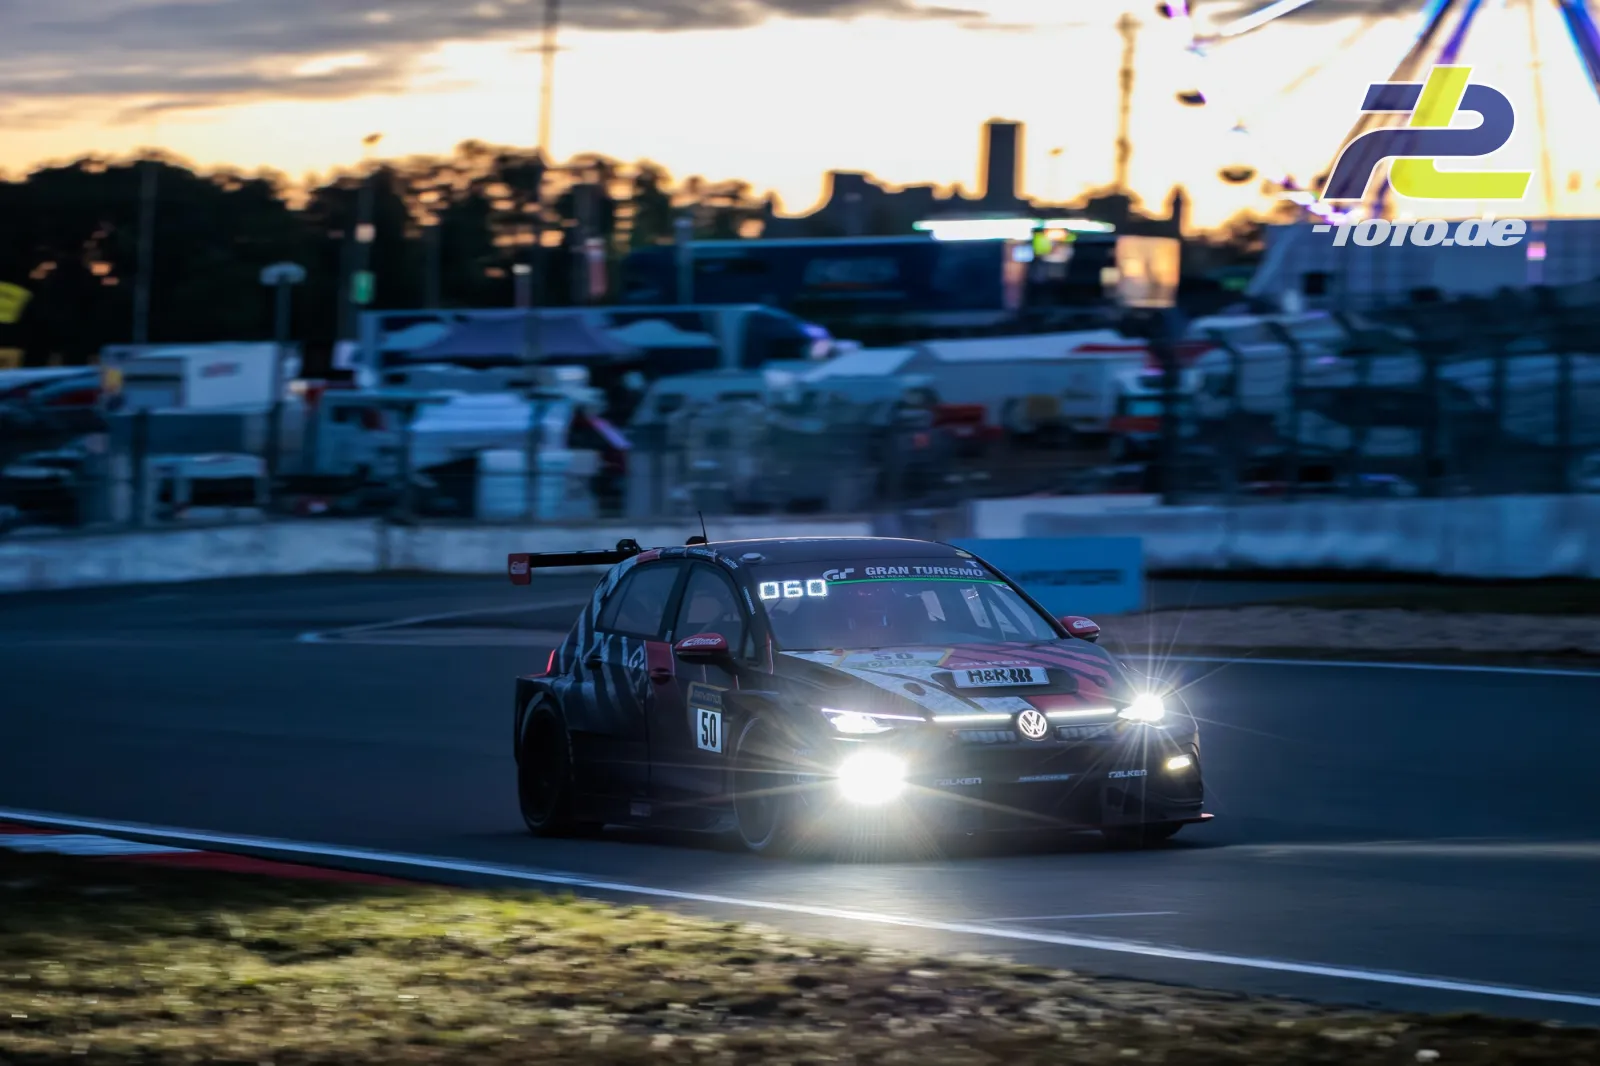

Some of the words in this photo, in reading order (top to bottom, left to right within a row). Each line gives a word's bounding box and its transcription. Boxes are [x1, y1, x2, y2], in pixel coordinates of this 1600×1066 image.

[864, 565, 908, 576] GRAN
[912, 565, 984, 578] TURISMO
[759, 578, 827, 602] 060
[966, 668, 1009, 684] H&R
[701, 711, 717, 748] 50
